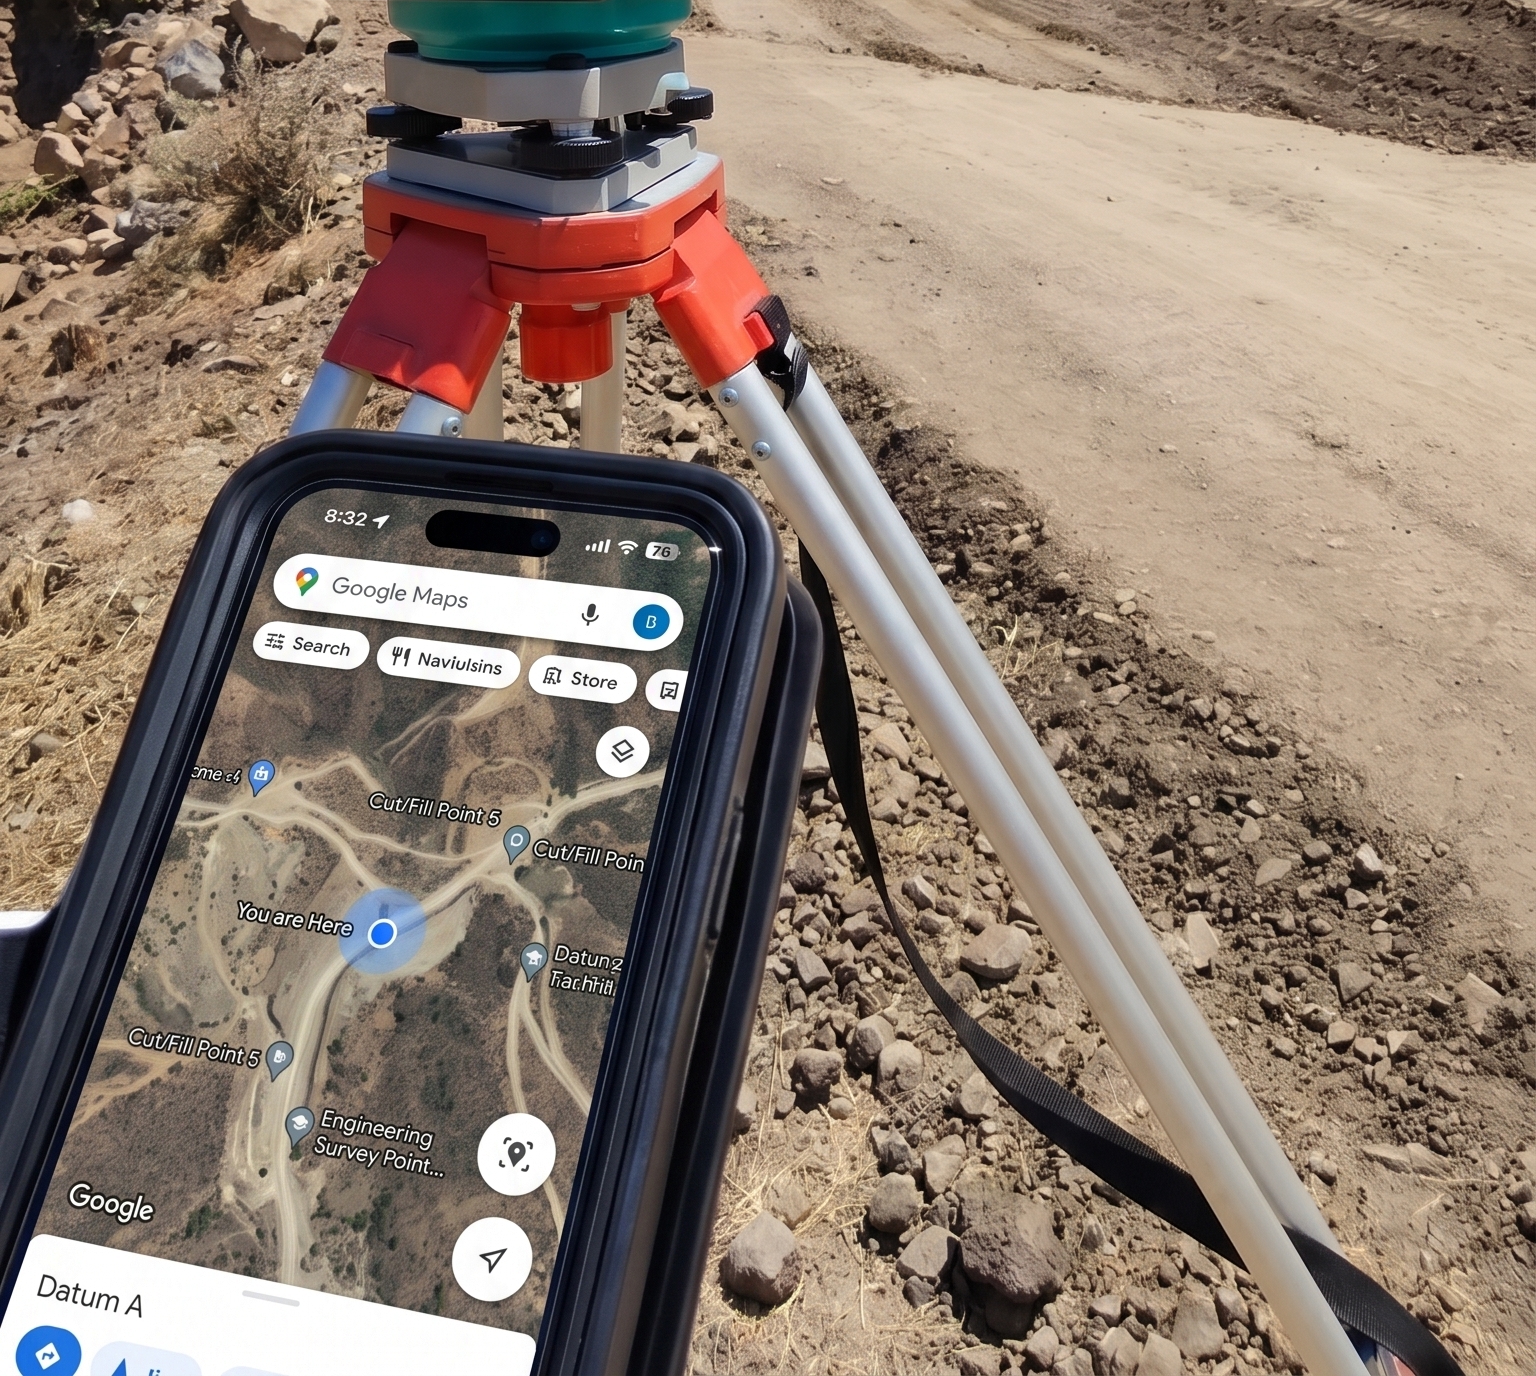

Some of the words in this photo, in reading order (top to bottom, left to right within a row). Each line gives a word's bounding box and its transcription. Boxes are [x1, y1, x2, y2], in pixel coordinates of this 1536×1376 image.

[324, 508, 368, 527] 8:32
[652, 545, 671, 558] 76
[332, 576, 407, 604] Google
[412, 585, 469, 611] Maps
[292, 636, 351, 657] Search
[417, 651, 503, 676] Naviulsins
[571, 671, 618, 691] Store
[369, 792, 434, 817] Cut/Fill
[436, 801, 485, 825] Point
[488, 810, 502, 827] 5
[533, 840, 601, 865] Cut/Fill
[604, 850, 646, 873] Poin
[238, 901, 271, 923] You
[273, 911, 304, 929] are
[307, 913, 354, 937] Here
[128, 1027, 195, 1055] Cut/Fill
[196, 1039, 245, 1065] Point
[247, 1050, 261, 1068] 5
[321, 1109, 434, 1151] Engineering
[314, 1136, 380, 1168] Survey
[383, 1149, 444, 1178] Point...
[69, 1183, 154, 1223] Google
[36, 1273, 120, 1313] Datum
[123, 1293, 143, 1319] A
